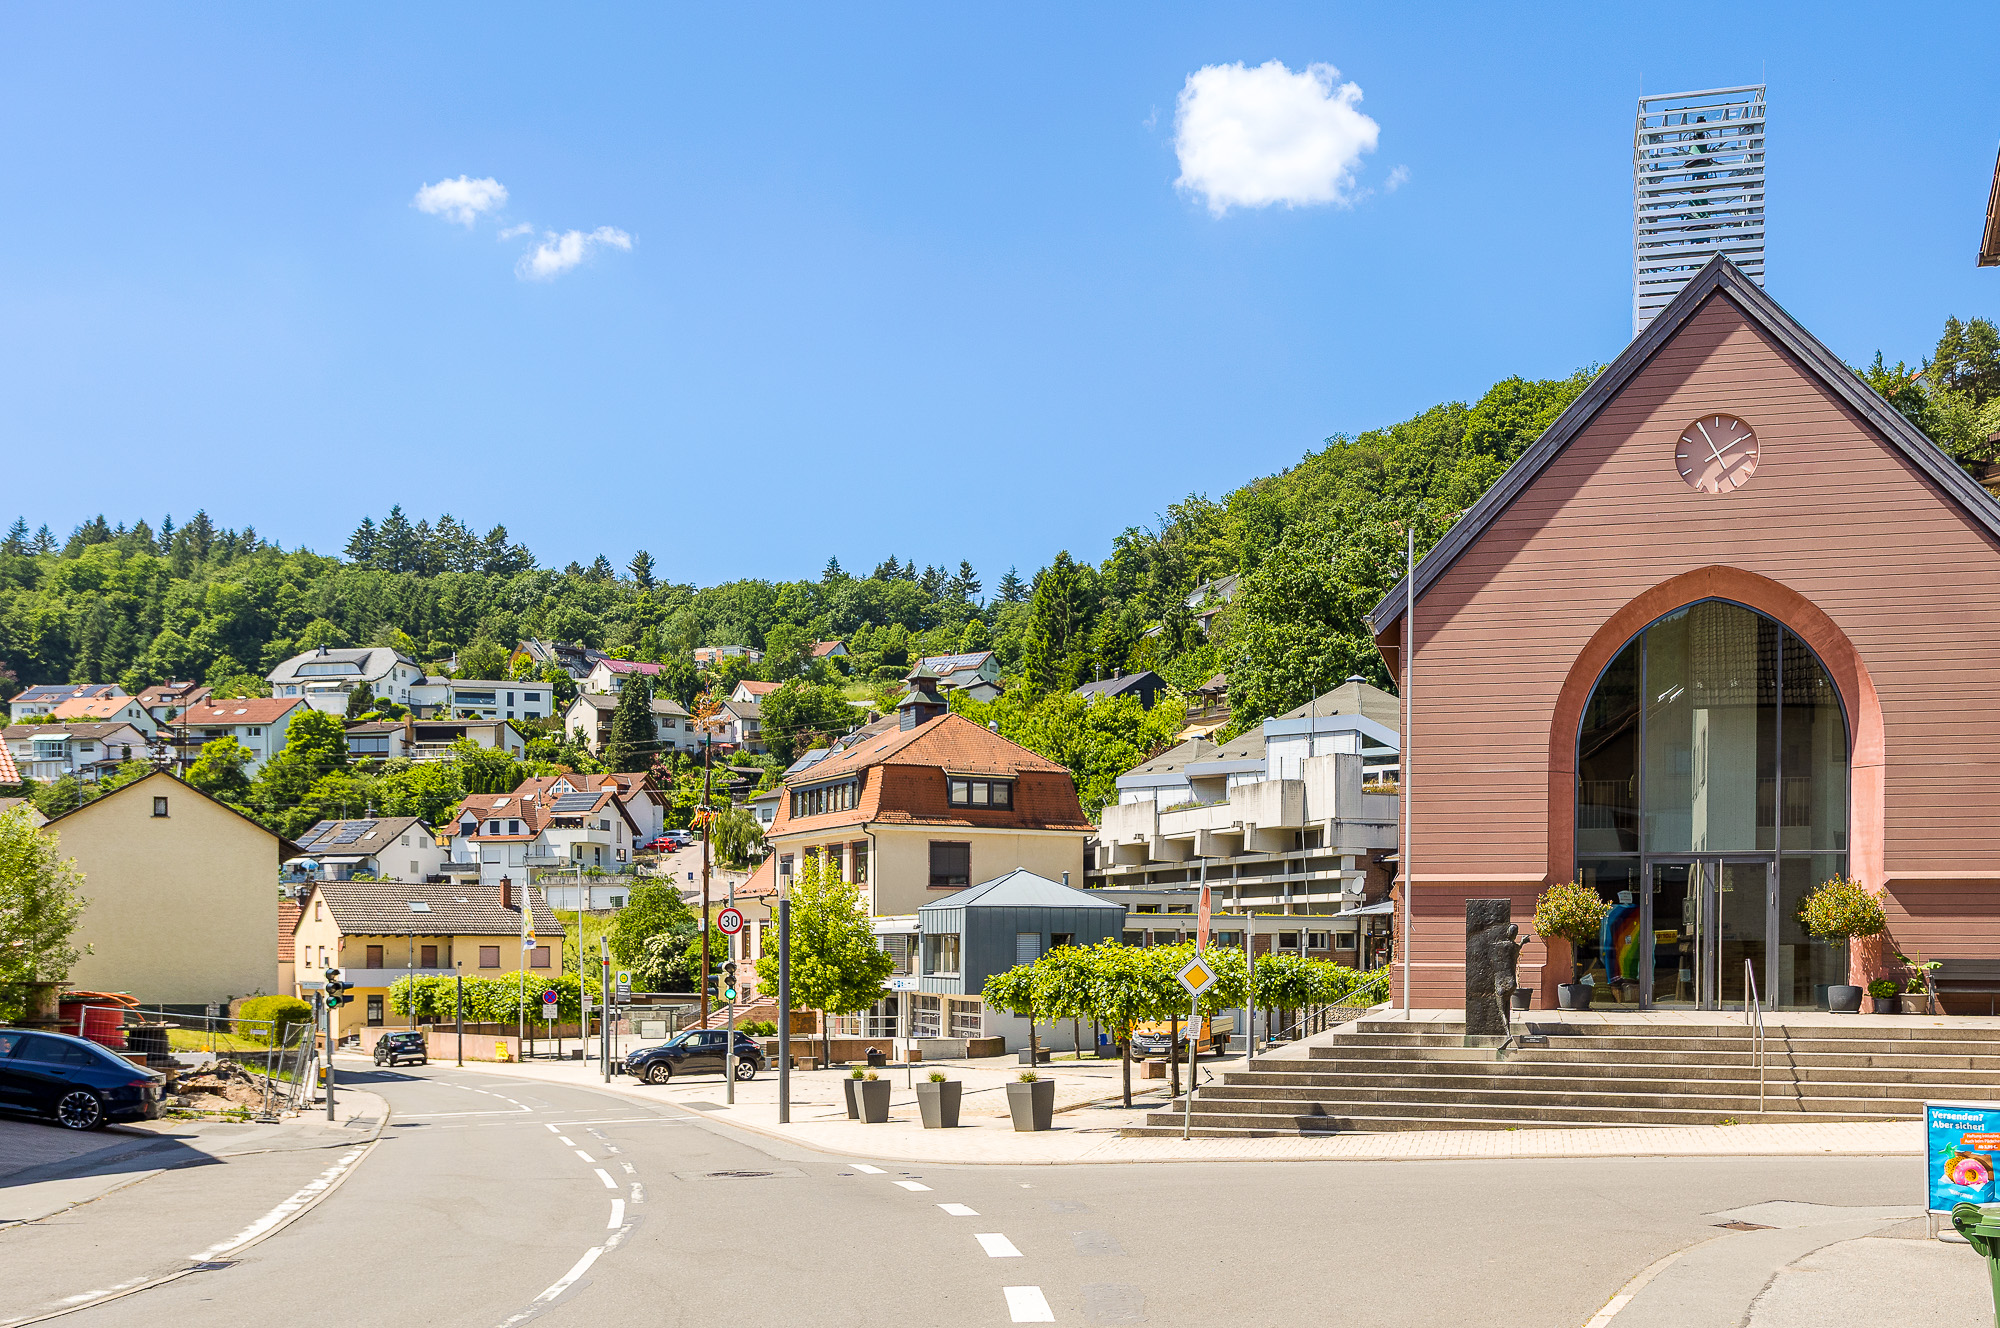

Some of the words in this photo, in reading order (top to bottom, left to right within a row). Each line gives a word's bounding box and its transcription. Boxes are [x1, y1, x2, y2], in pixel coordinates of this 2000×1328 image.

[723, 915, 738, 927] 30
[1932, 1111, 1984, 1121] Versenden?
[1932, 1120, 1953, 1129] Aber
[1955, 1122, 1985, 1131] sicher!
